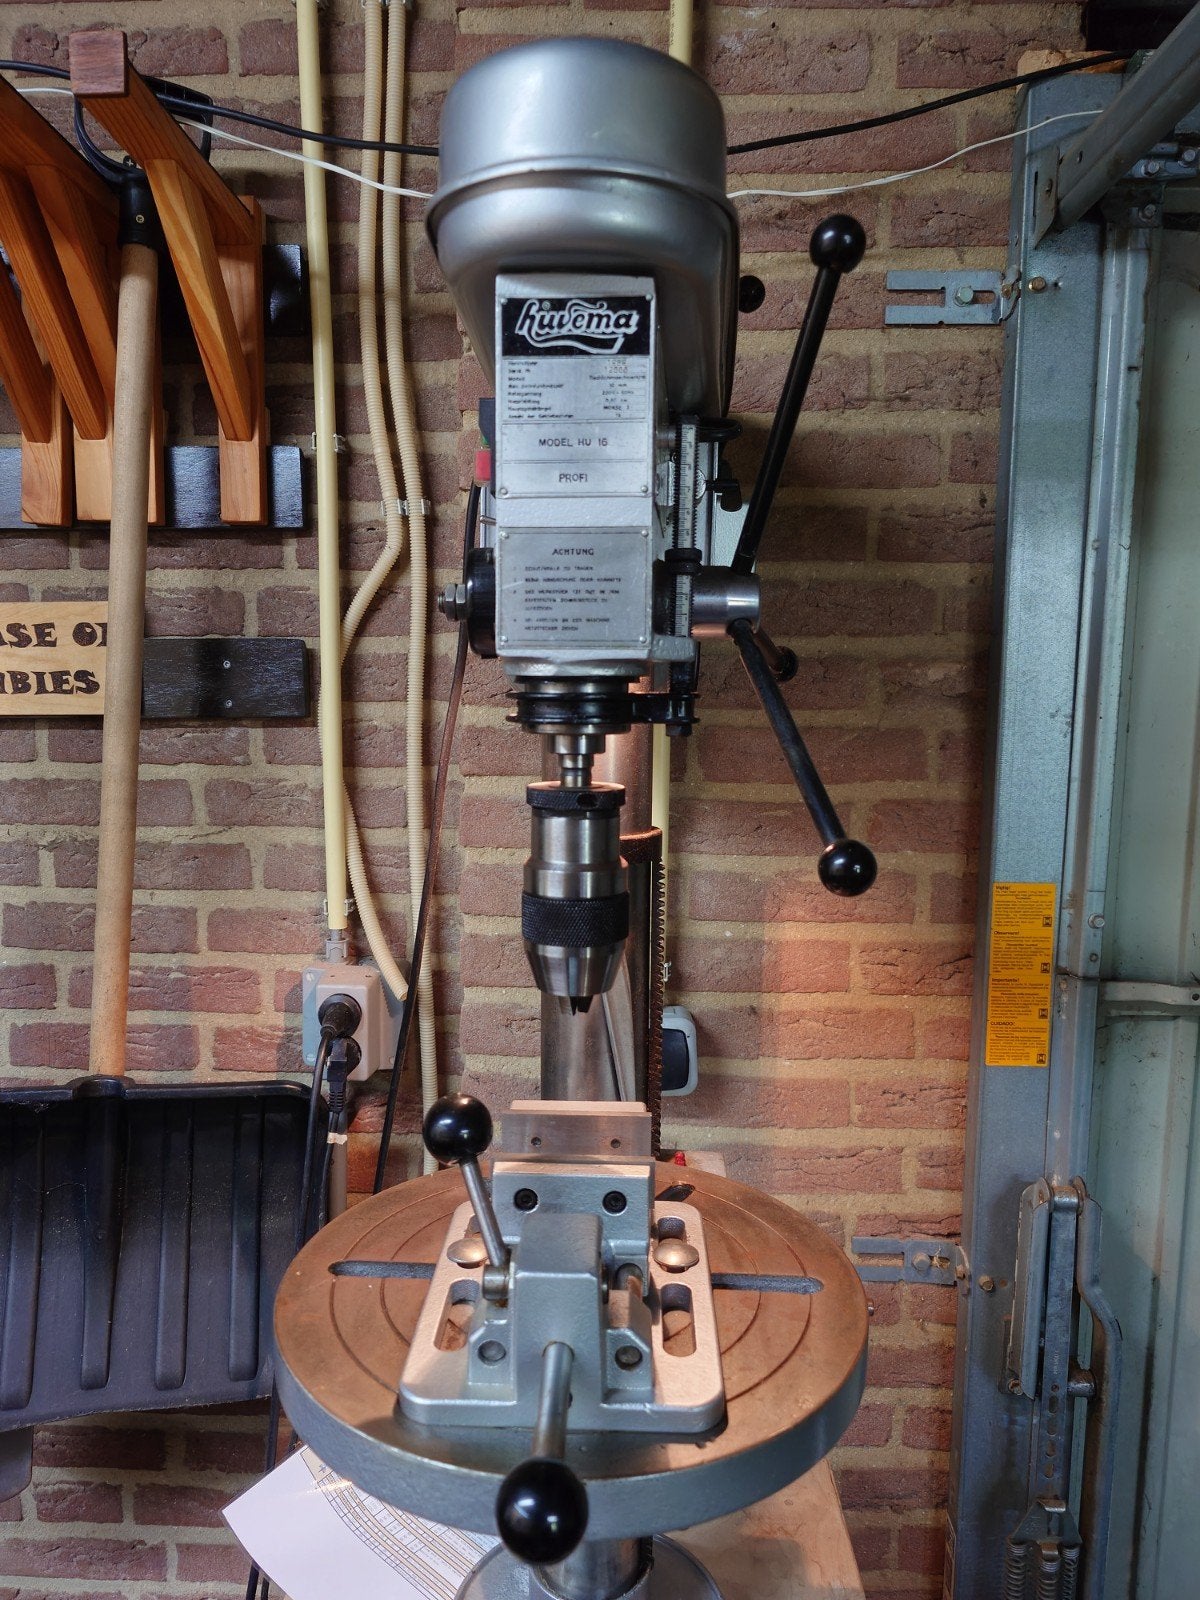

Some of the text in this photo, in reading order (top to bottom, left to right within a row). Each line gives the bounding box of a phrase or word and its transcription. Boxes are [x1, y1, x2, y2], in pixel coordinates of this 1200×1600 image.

[538, 437, 608, 447] MODEL HU 16
[558, 473, 588, 483] PROFI
[551, 548, 594, 556] ACHTUNG
[0, 621, 58, 648] SE
